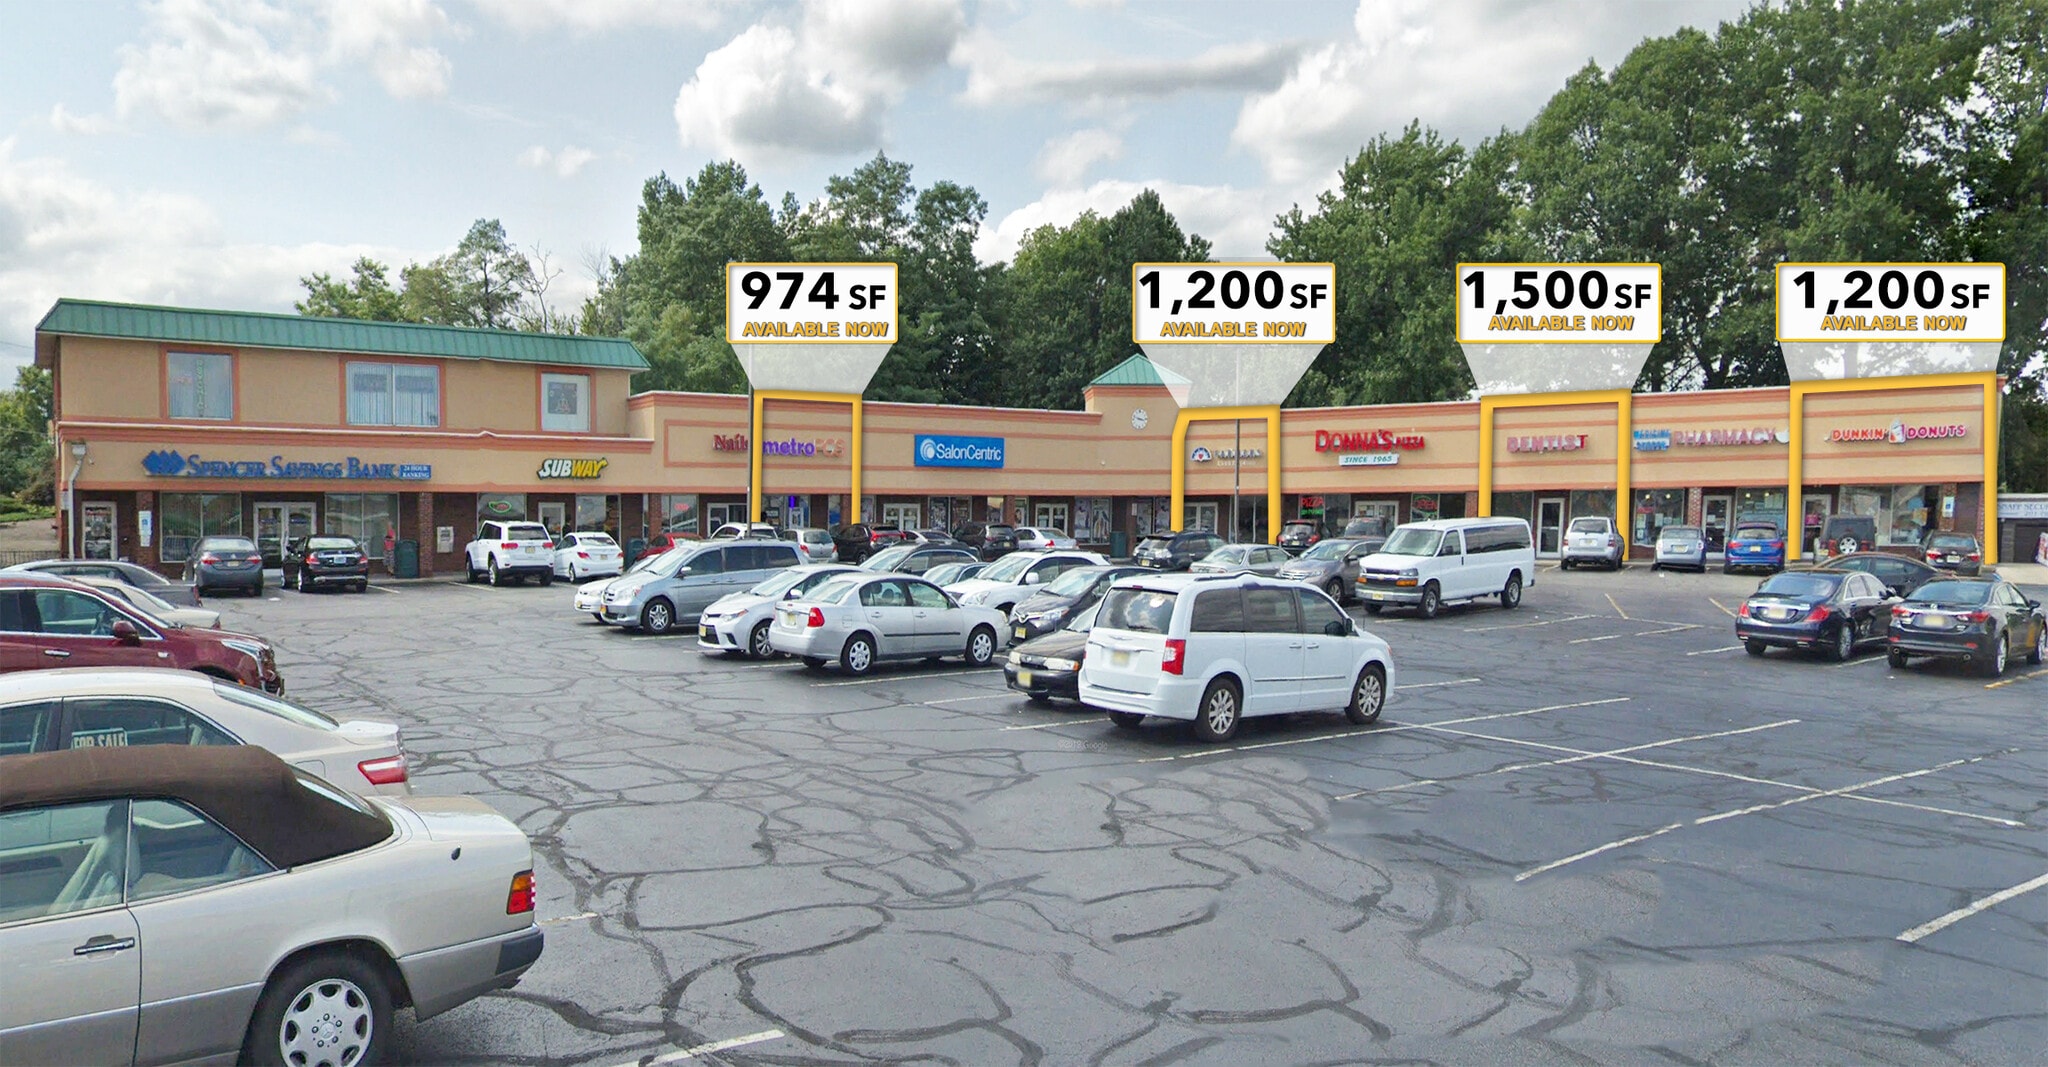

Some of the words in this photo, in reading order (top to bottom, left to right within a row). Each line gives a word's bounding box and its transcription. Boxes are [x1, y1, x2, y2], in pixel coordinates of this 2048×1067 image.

[1673, 428, 1776, 446] PHARMACY
[1907, 424, 1967, 439] DONUTS
[1315, 429, 1394, 453] DONNA'S
[1396, 436, 1425, 451] PIZZA
[1507, 434, 1588, 452] DENTIST
[936, 443, 1002, 461] SalonCentric
[187, 453, 265, 478] SPENCER
[271, 455, 342, 478] SAVINGS
[346, 456, 396, 478] BANK
[537, 457, 608, 479] SUBWAY
